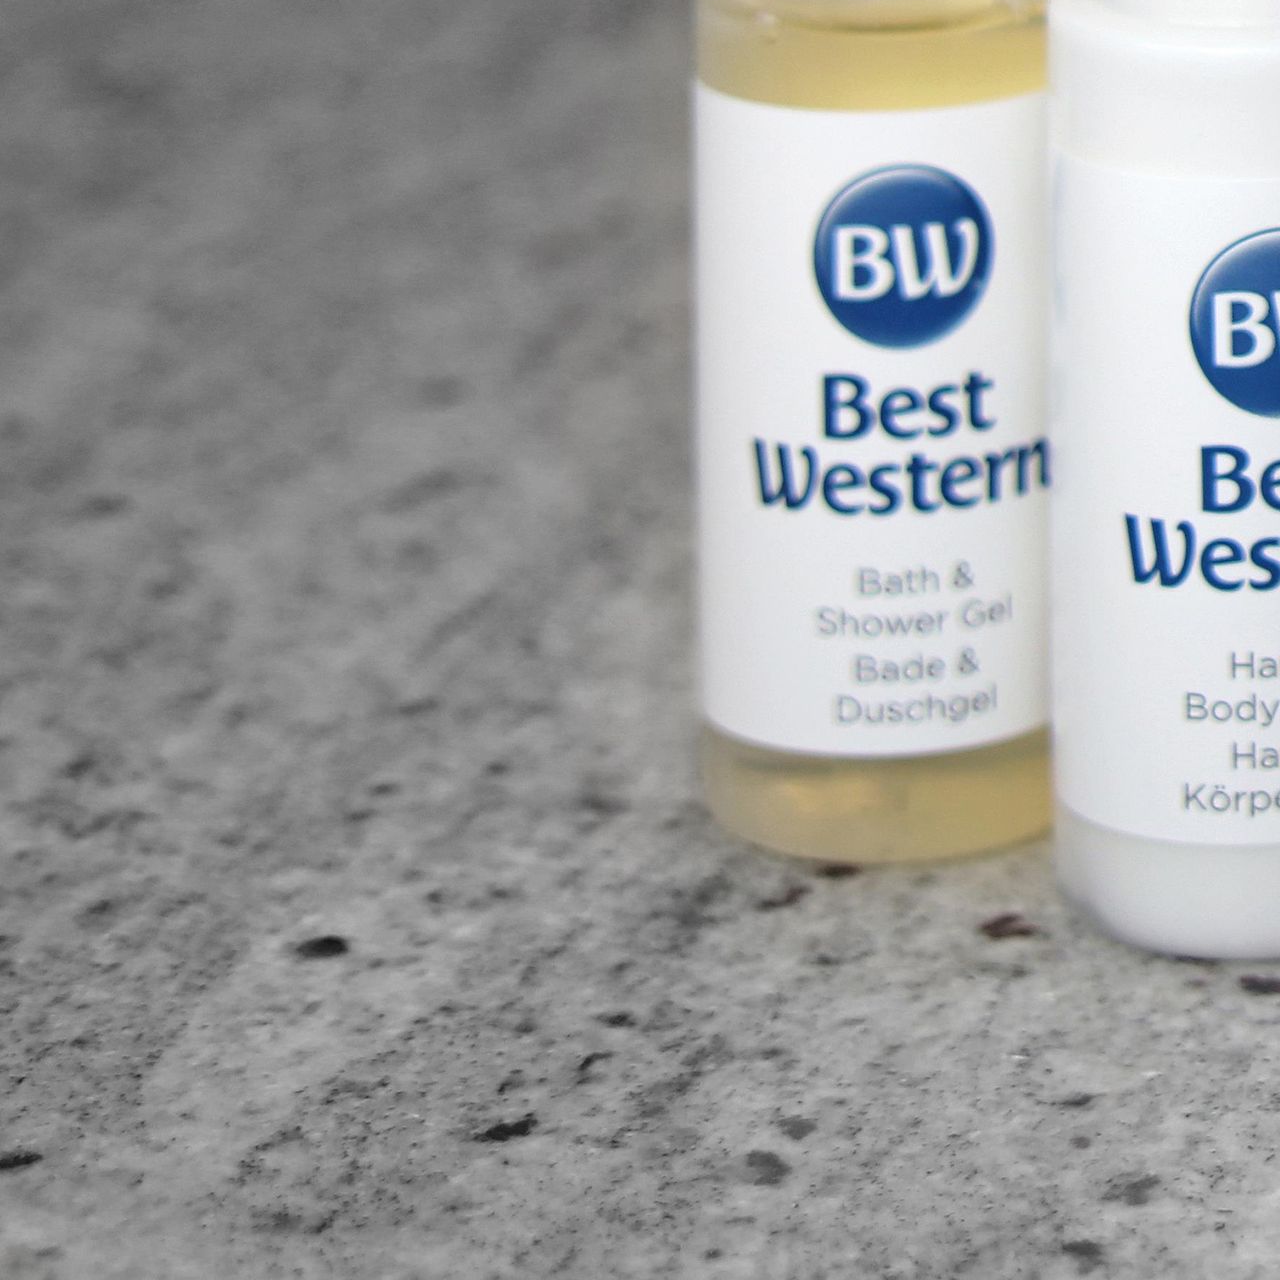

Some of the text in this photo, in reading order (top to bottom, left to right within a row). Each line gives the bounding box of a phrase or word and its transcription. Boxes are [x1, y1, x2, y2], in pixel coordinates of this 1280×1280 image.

[831, 218, 980, 302] BW
[821, 372, 994, 441] Best
[752, 436, 1051, 515] Western
[857, 561, 975, 596] Bath &
[817, 594, 1013, 637] Shower Gel
[853, 647, 981, 684] Bade &
[834, 685, 999, 726] Duschgel
[1185, 690, 1280, 726] Body
